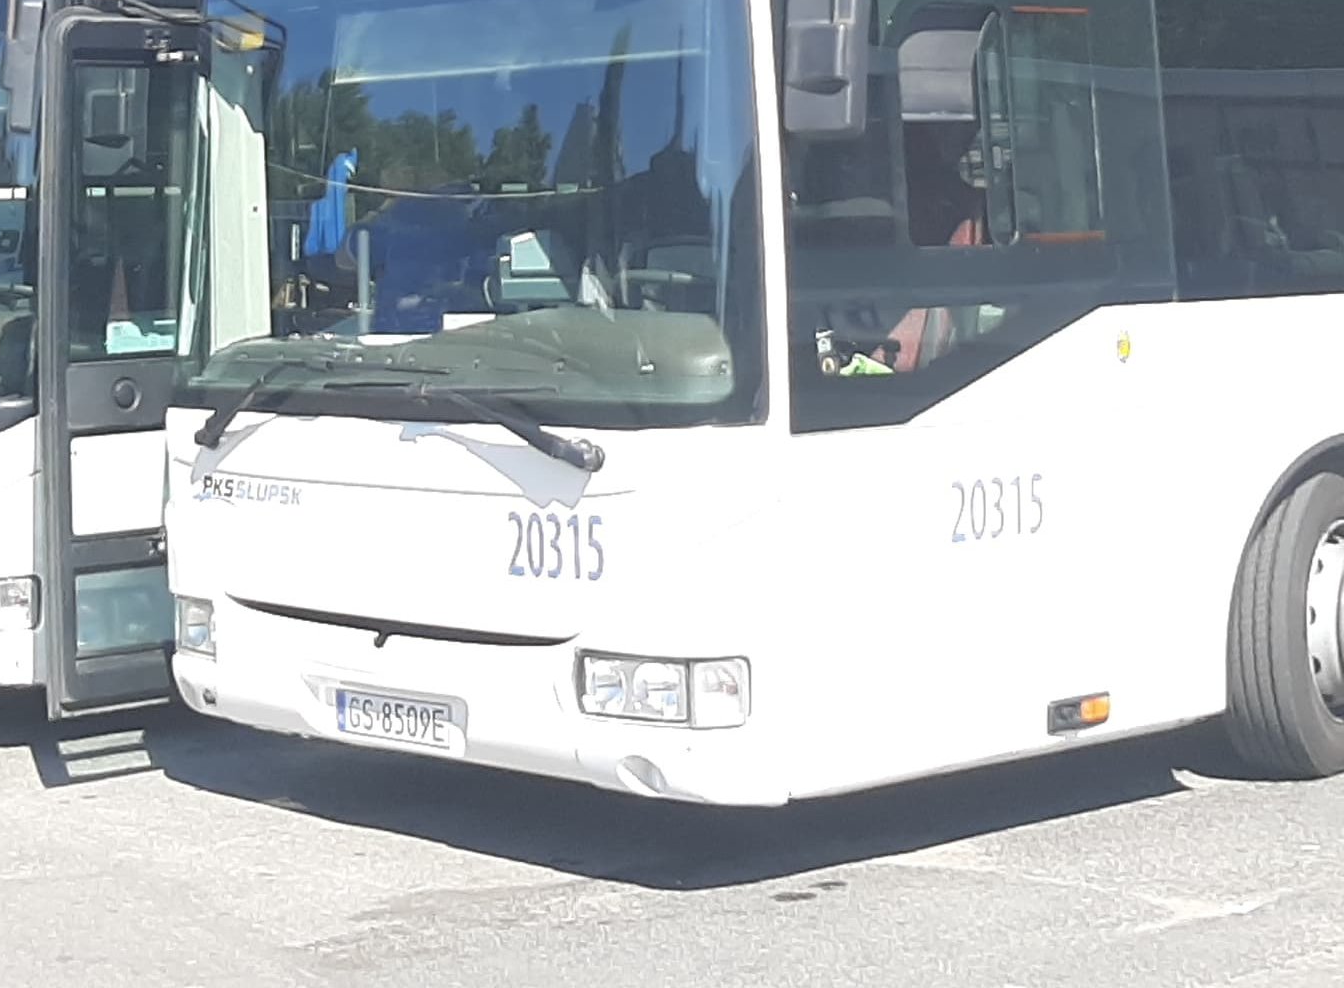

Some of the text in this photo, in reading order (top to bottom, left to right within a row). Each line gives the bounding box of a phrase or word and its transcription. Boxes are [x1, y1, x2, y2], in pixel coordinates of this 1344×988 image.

[203, 475, 234, 499] PKS
[951, 473, 1043, 543] 20315
[507, 510, 605, 582] 20315
[381, 701, 445, 742] 8509E
